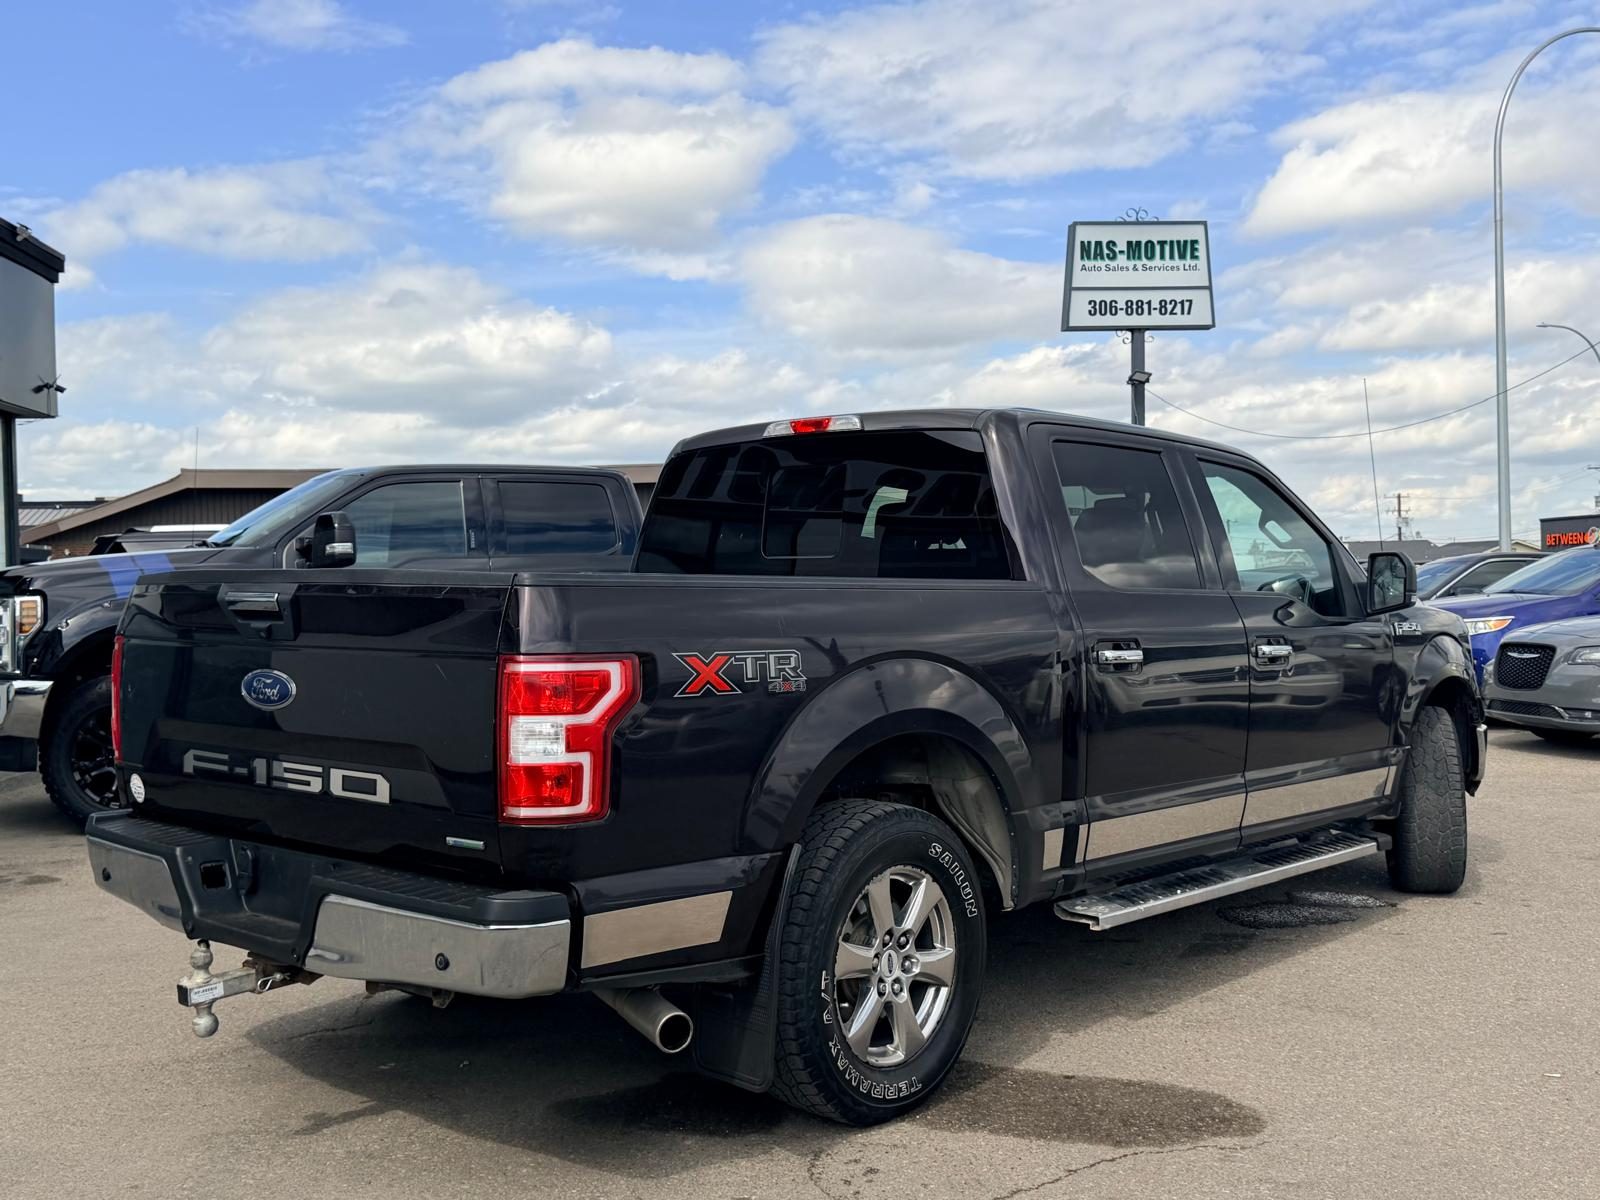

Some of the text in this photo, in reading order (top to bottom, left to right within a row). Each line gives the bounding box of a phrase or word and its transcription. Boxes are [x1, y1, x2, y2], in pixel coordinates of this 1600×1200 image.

[1079, 239, 1200, 262] NAS-MOTIVE
[1080, 263, 1200, 272] Auto Sales & Services Ltd.
[1088, 299, 1193, 316] 306-881-8217
[1546, 532, 1584, 546] BETWEEN
[671, 649, 807, 698] XTR
[251, 677, 280, 700] Ford
[183, 749, 391, 804] F-150
[928, 842, 978, 918] SAILUN
[829, 1034, 922, 1100] TERRAMAX
